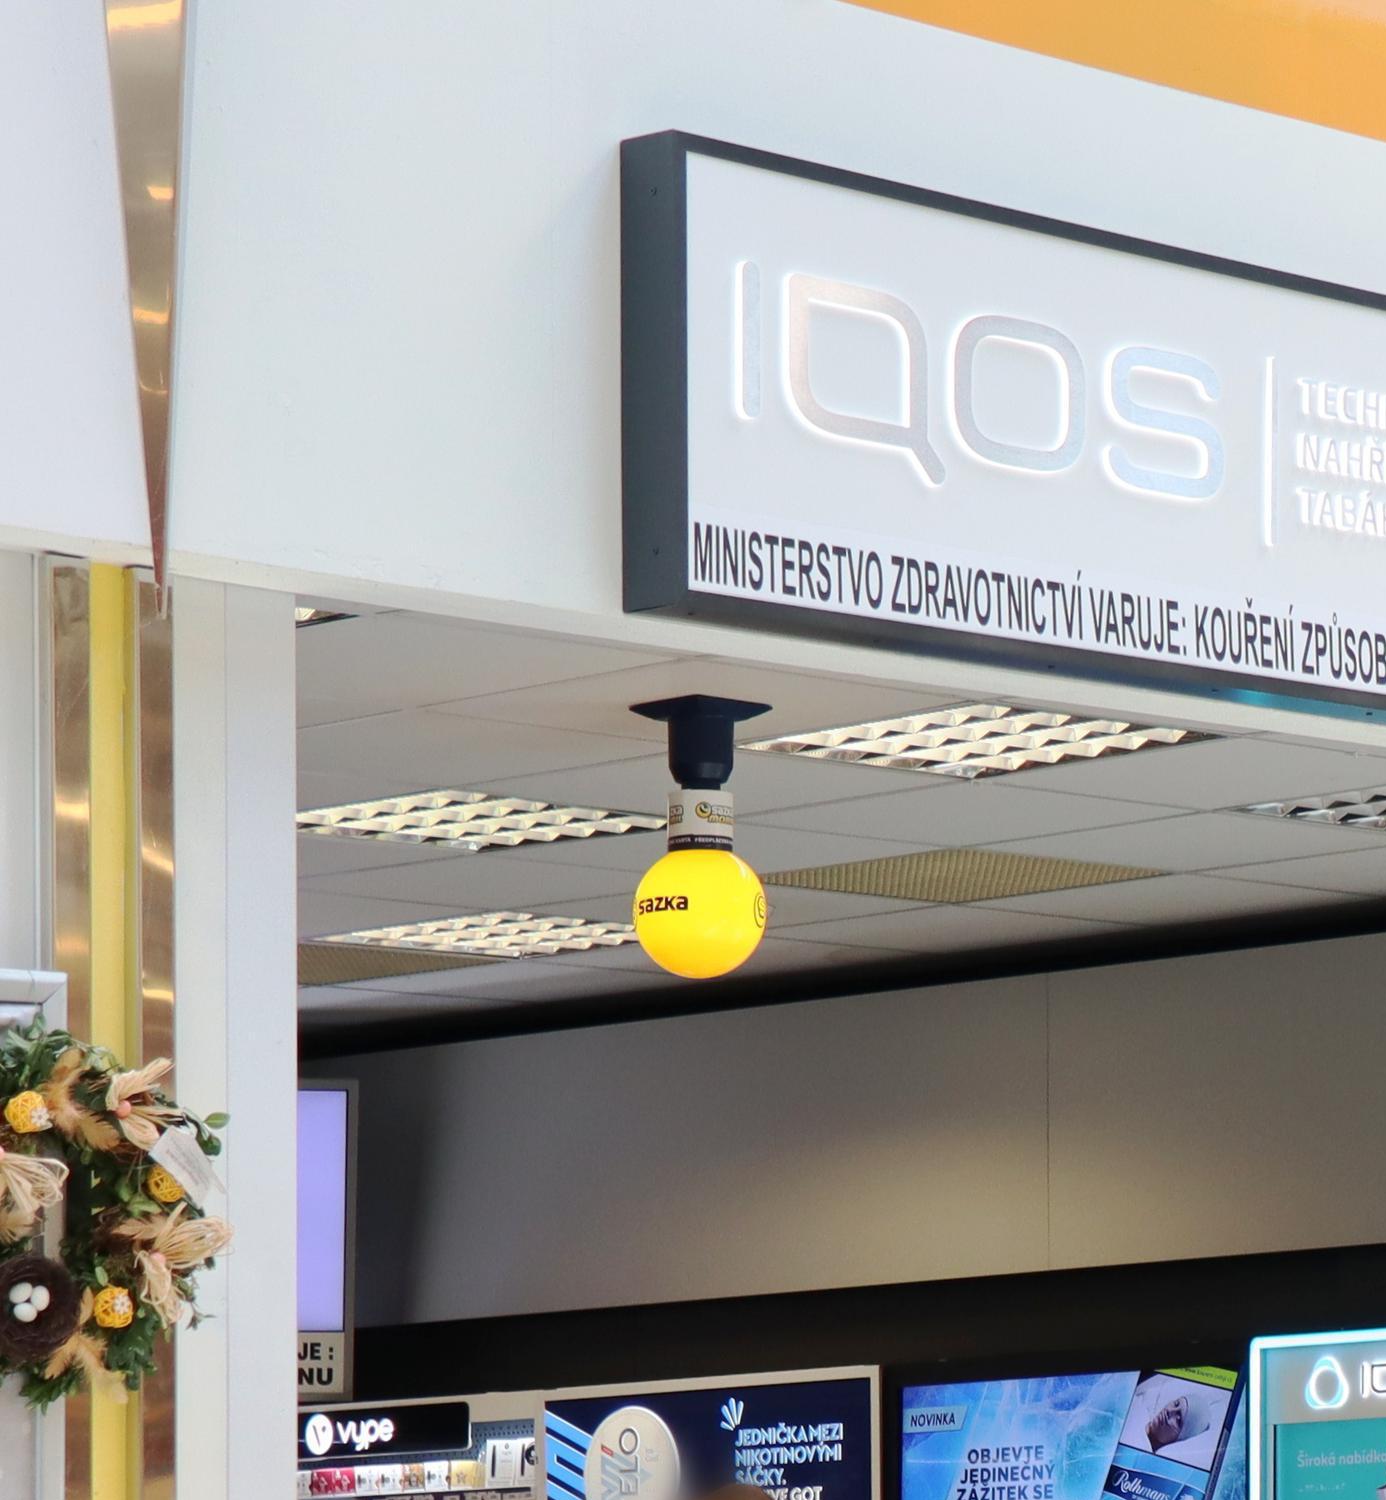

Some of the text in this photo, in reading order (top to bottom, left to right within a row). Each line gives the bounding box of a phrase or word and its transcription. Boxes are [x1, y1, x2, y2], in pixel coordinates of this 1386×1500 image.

[735, 260, 1226, 500] IQOS
[693, 521, 884, 609] MINISTERSTVO
[891, 555, 1084, 641] ZDRAVOTNICTVÍ
[1089, 587, 1188, 657] VARUJE:
[1194, 598, 1296, 673] KOUŘENÍ
[638, 895, 689, 916] sazka
[910, 1412, 956, 1428] NOVINKA
[336, 1417, 395, 1452] vype
[735, 1422, 844, 1447] JEDNIČKA MEZI
[735, 1441, 843, 1467] NIKOTINOVÝMI
[967, 1445, 1044, 1464] OBJEVTE
[1296, 1449, 1337, 1468] Široká
[960, 1459, 1056, 1485] JEDINEČNÝ
[1033, 1483, 1054, 1500] SE
